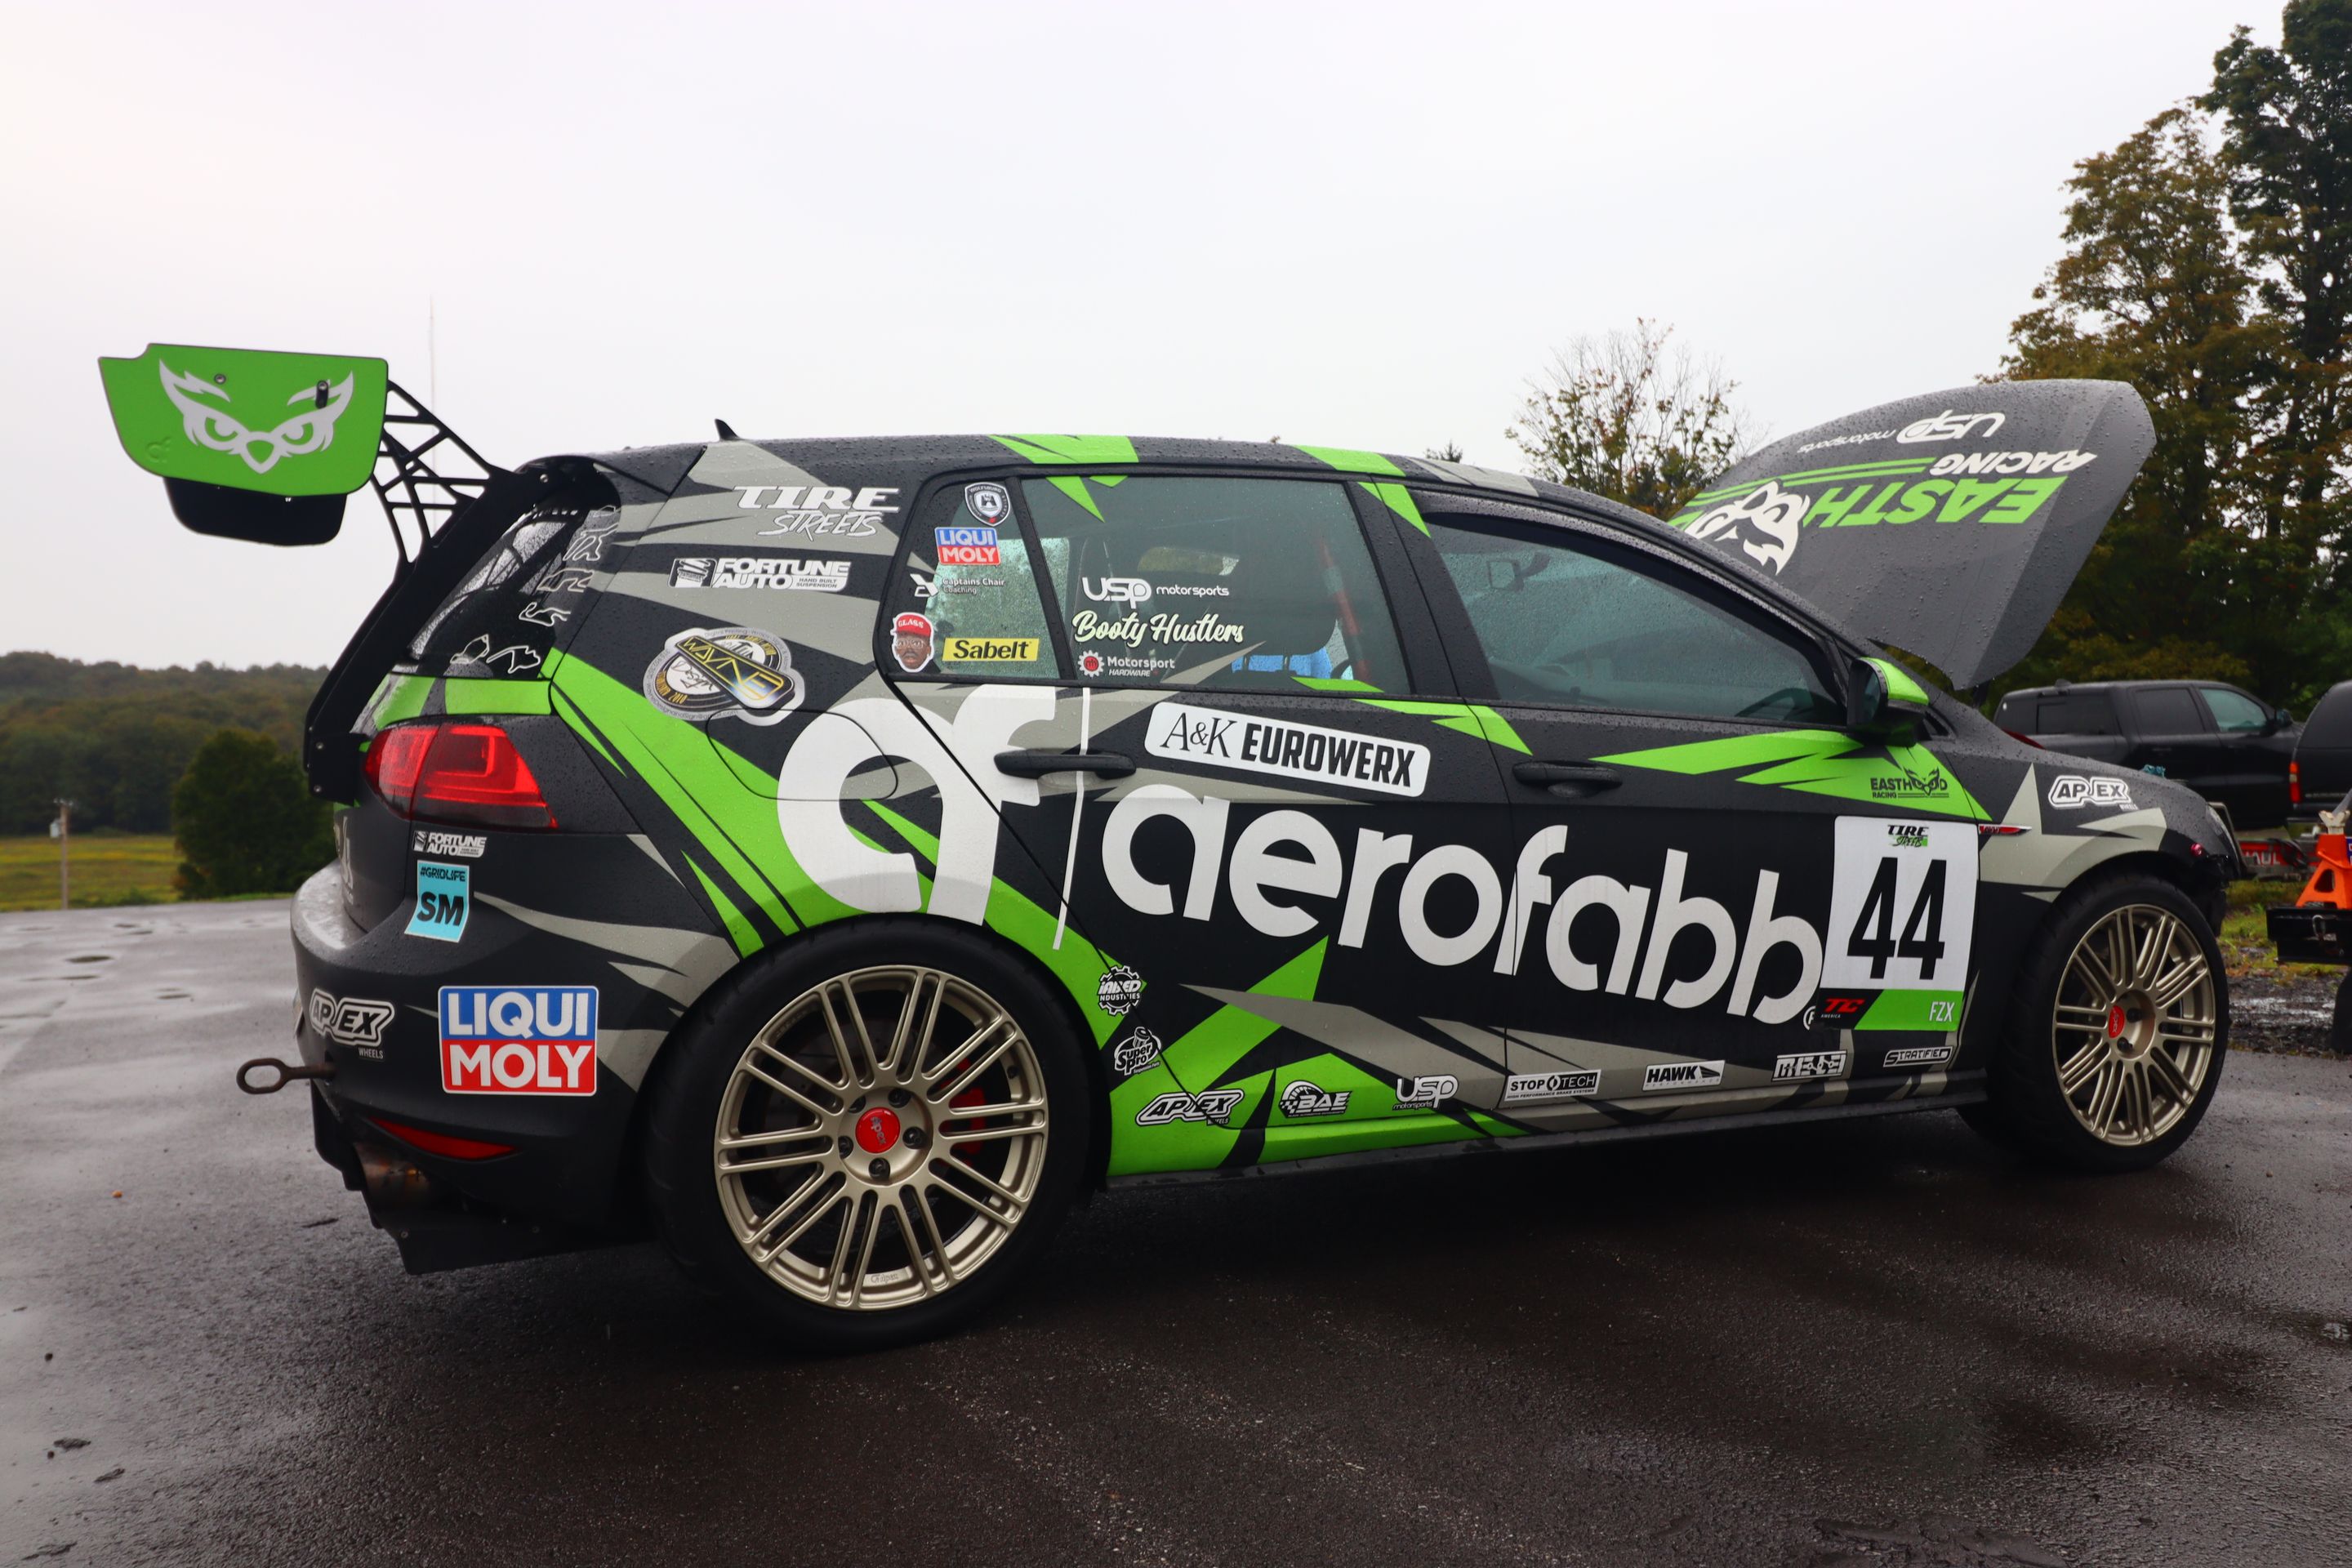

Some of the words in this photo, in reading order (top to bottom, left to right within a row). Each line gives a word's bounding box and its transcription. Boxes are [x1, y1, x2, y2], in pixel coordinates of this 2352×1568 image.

[1930, 449, 2098, 475] RACING
[733, 486, 900, 511] TIRE
[757, 510, 884, 541] STREETS
[939, 530, 994, 546] LIQUI
[942, 546, 996, 563] MOLY
[716, 558, 852, 577] FORTUNE
[712, 573, 794, 589] AUTO
[942, 578, 980, 588] Captains
[982, 578, 1005, 586] Chair
[943, 586, 977, 595] Coaching
[1156, 584, 1230, 598] motorsports
[898, 617, 924, 629] GLASS
[1071, 610, 1148, 648] Booty
[1150, 612, 1245, 644] Hustlers
[953, 639, 1029, 659] Sabelt
[1107, 657, 1176, 671] Motorsport
[1108, 669, 1151, 677] HARDWARE
[1160, 712, 1237, 758] A&K
[1241, 723, 1415, 788] EUROWERX
[2052, 778, 2127, 803] APEX
[1887, 824, 1929, 836] TIRE
[427, 832, 488, 848] FORTUNE
[426, 842, 457, 856] AUTO
[420, 866, 466, 882] #GRIDLIFE
[416, 891, 465, 927] SM
[1102, 783, 1824, 1025] aerofabb
[1846, 856, 1948, 981] 44
[1824, 998, 1866, 1013] TC
[1928, 1001, 1955, 1022] FZX
[448, 991, 590, 1040] LIQUI
[358, 1047, 384, 1059] WHEELS
[1883, 1045, 1953, 1067] STRATIFIED
[449, 1043, 593, 1089] MOLY
[1646, 1066, 1699, 1083] HAWK
[1300, 1092, 1352, 1108] BAE
